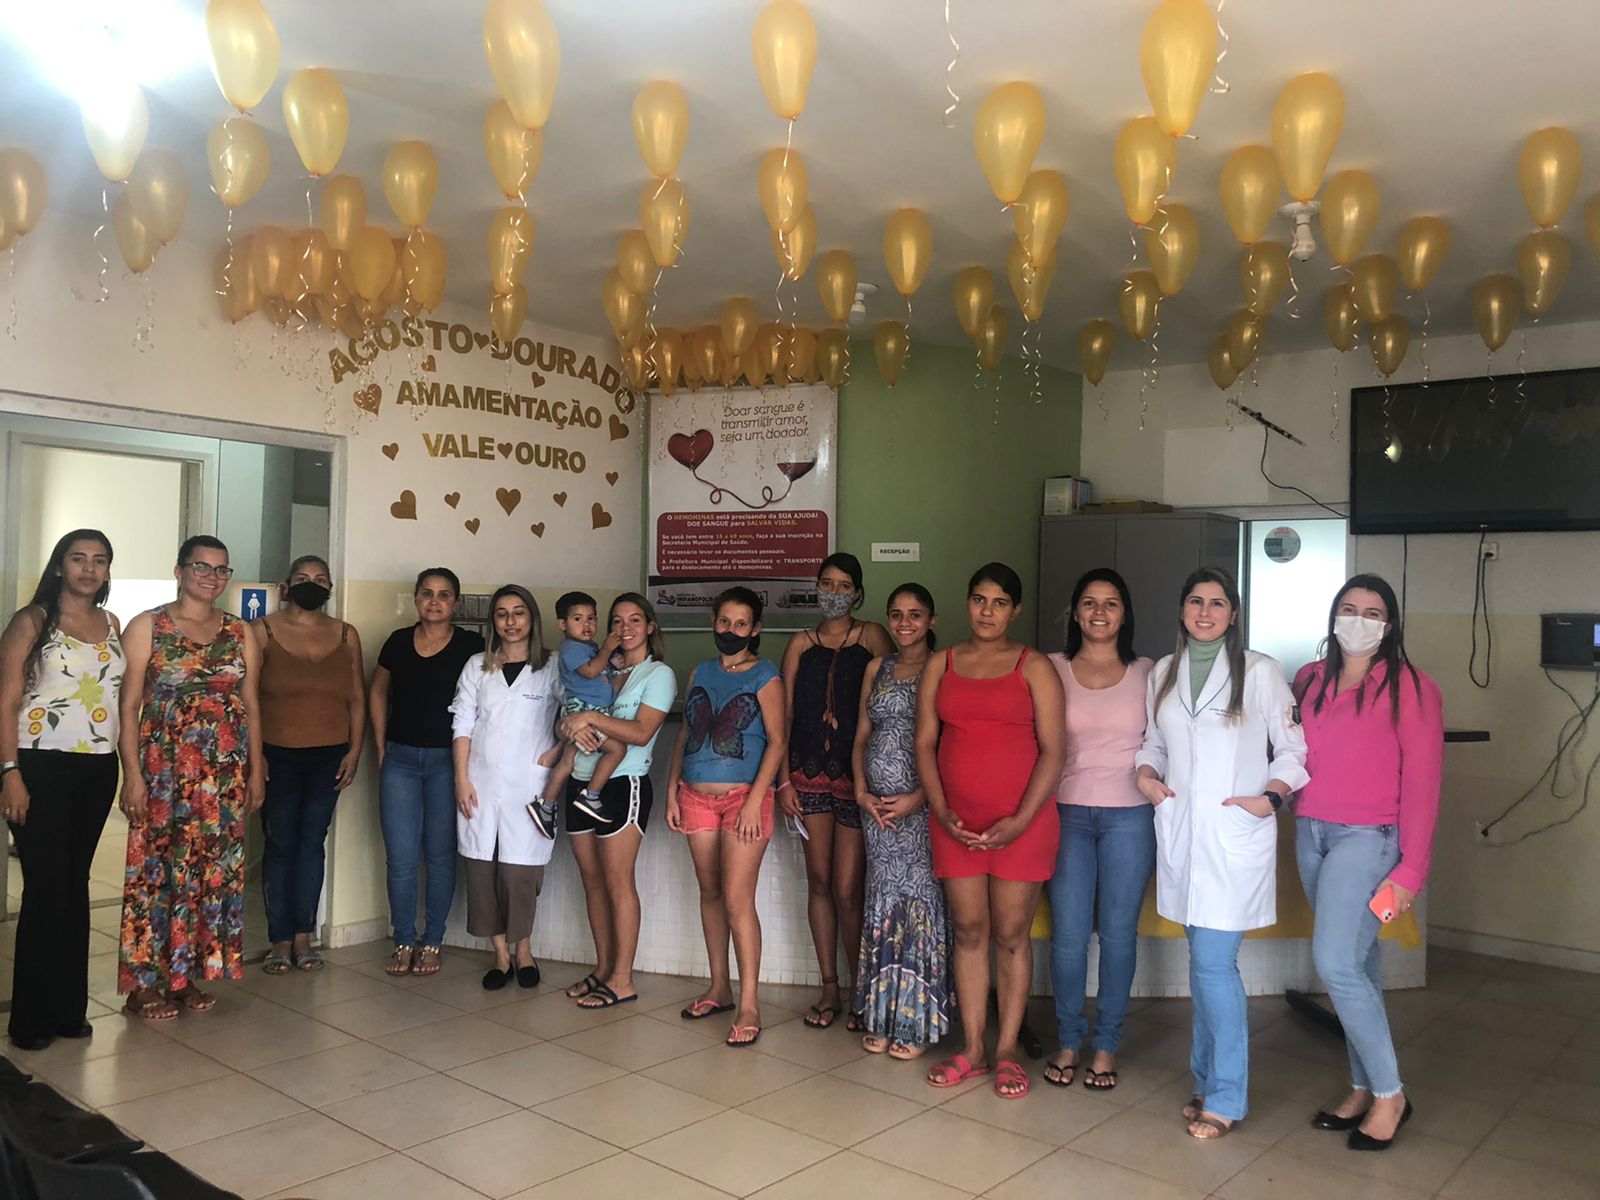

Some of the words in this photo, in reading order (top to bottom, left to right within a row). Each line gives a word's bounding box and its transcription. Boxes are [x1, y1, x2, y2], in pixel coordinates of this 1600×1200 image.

[328, 317, 474, 385] AGOSTO
[491, 330, 636, 415] DOURADO
[396, 380, 603, 430] AMAMENTAÇÃO
[723, 406, 752, 417] Doar
[753, 403, 795, 416] sangue
[797, 400, 805, 411] é
[721, 416, 774, 430] transmitir
[775, 415, 808, 427] amor,
[720, 432, 742, 444] seja
[765, 427, 809, 439] doador.
[422, 432, 496, 460] VALE
[515, 441, 587, 474] OURO
[730, 520, 745, 528] para
[731, 512, 767, 521] precisando
[768, 511, 777, 519] da
